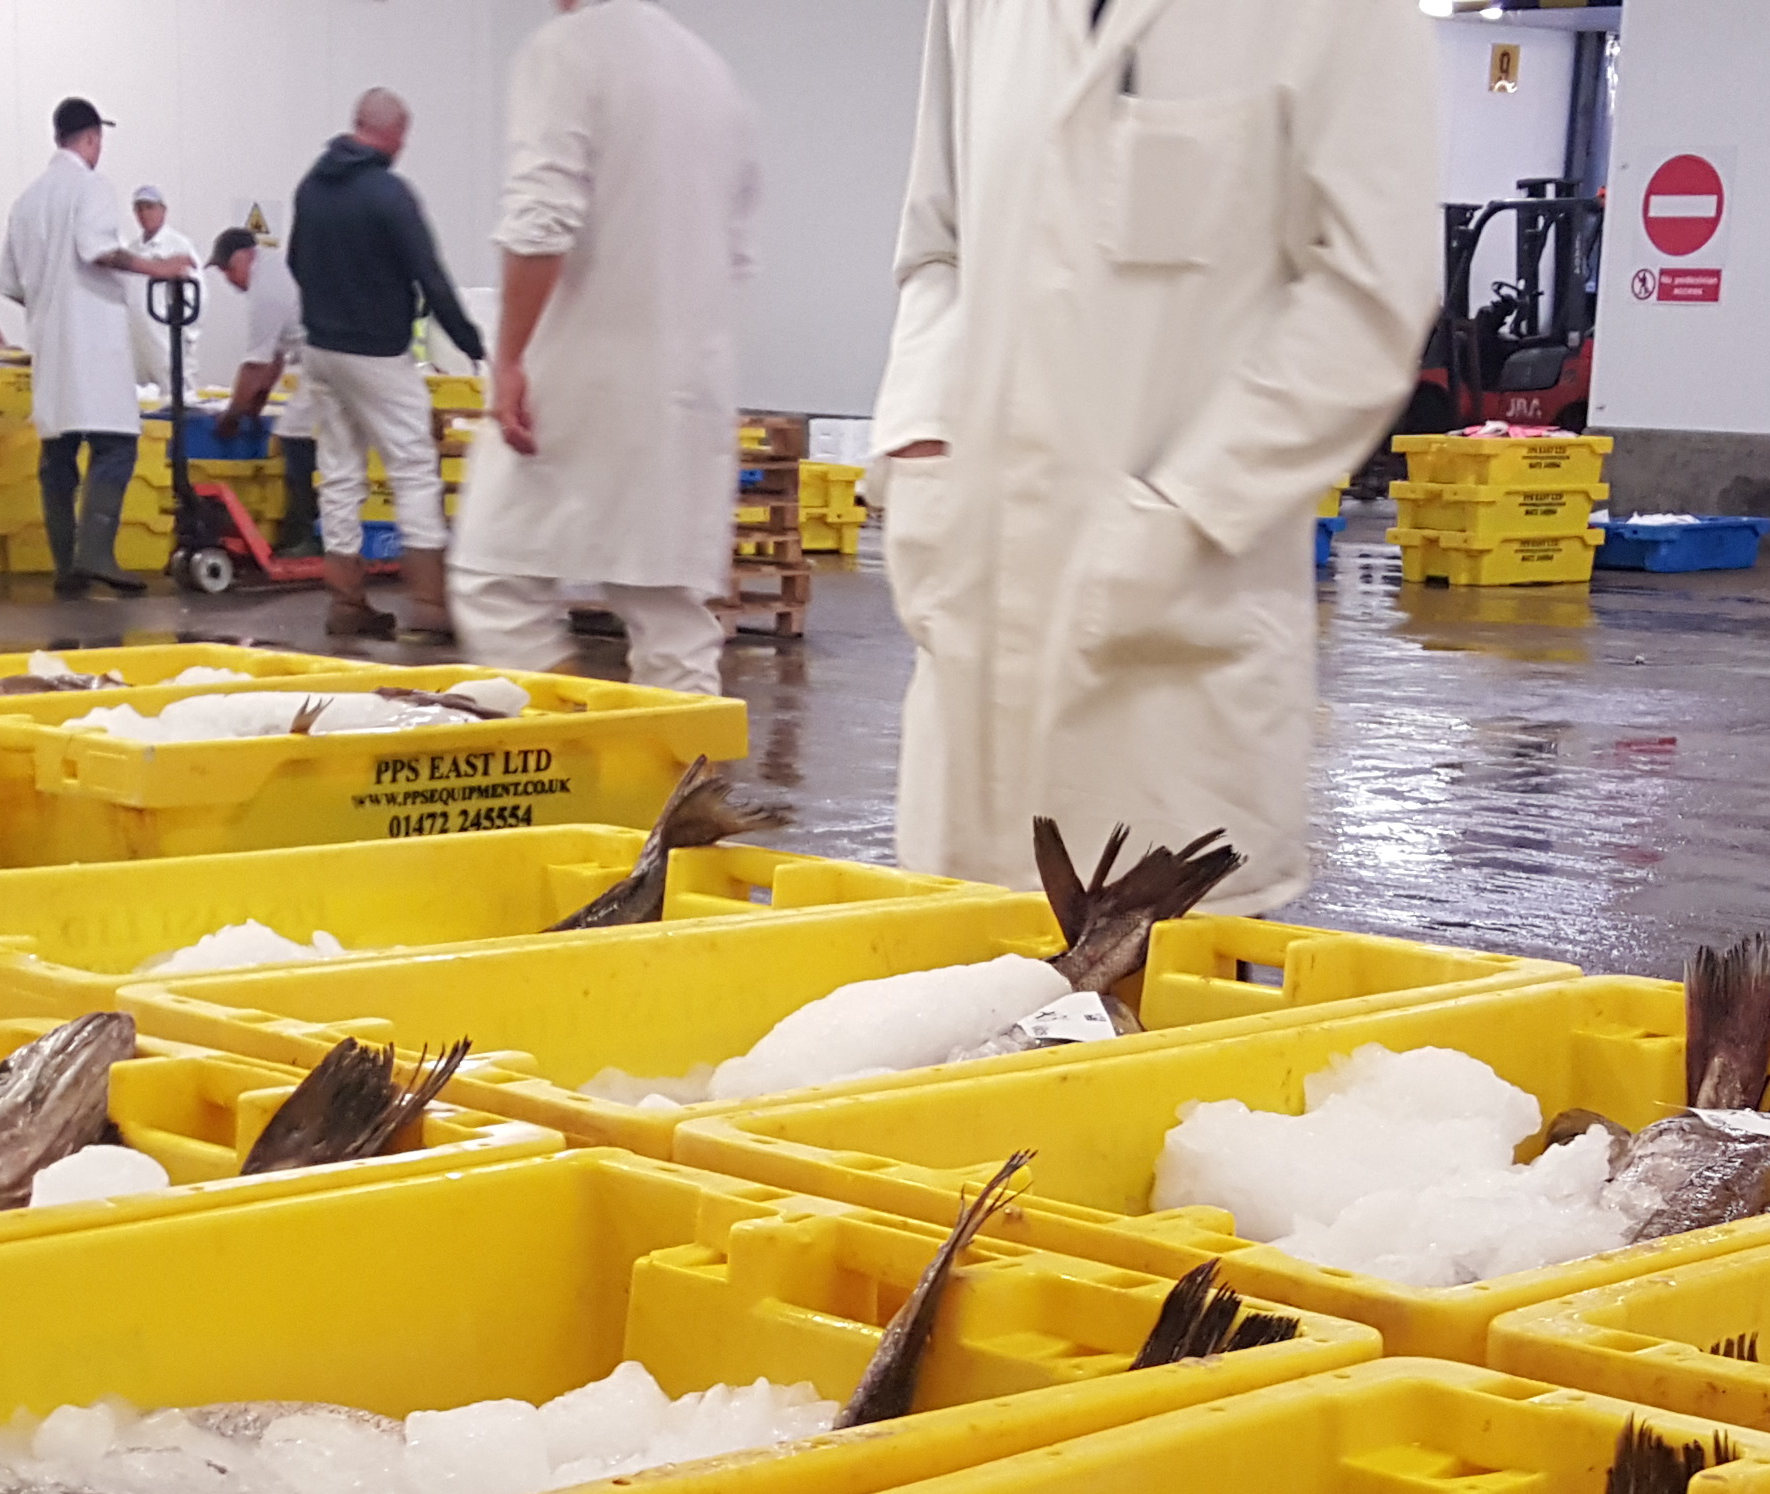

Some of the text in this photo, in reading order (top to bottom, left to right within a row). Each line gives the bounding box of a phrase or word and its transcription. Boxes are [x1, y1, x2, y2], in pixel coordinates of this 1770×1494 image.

[375, 749, 552, 784] PPS EAST LTD
[389, 804, 533, 838] 01472 245554
